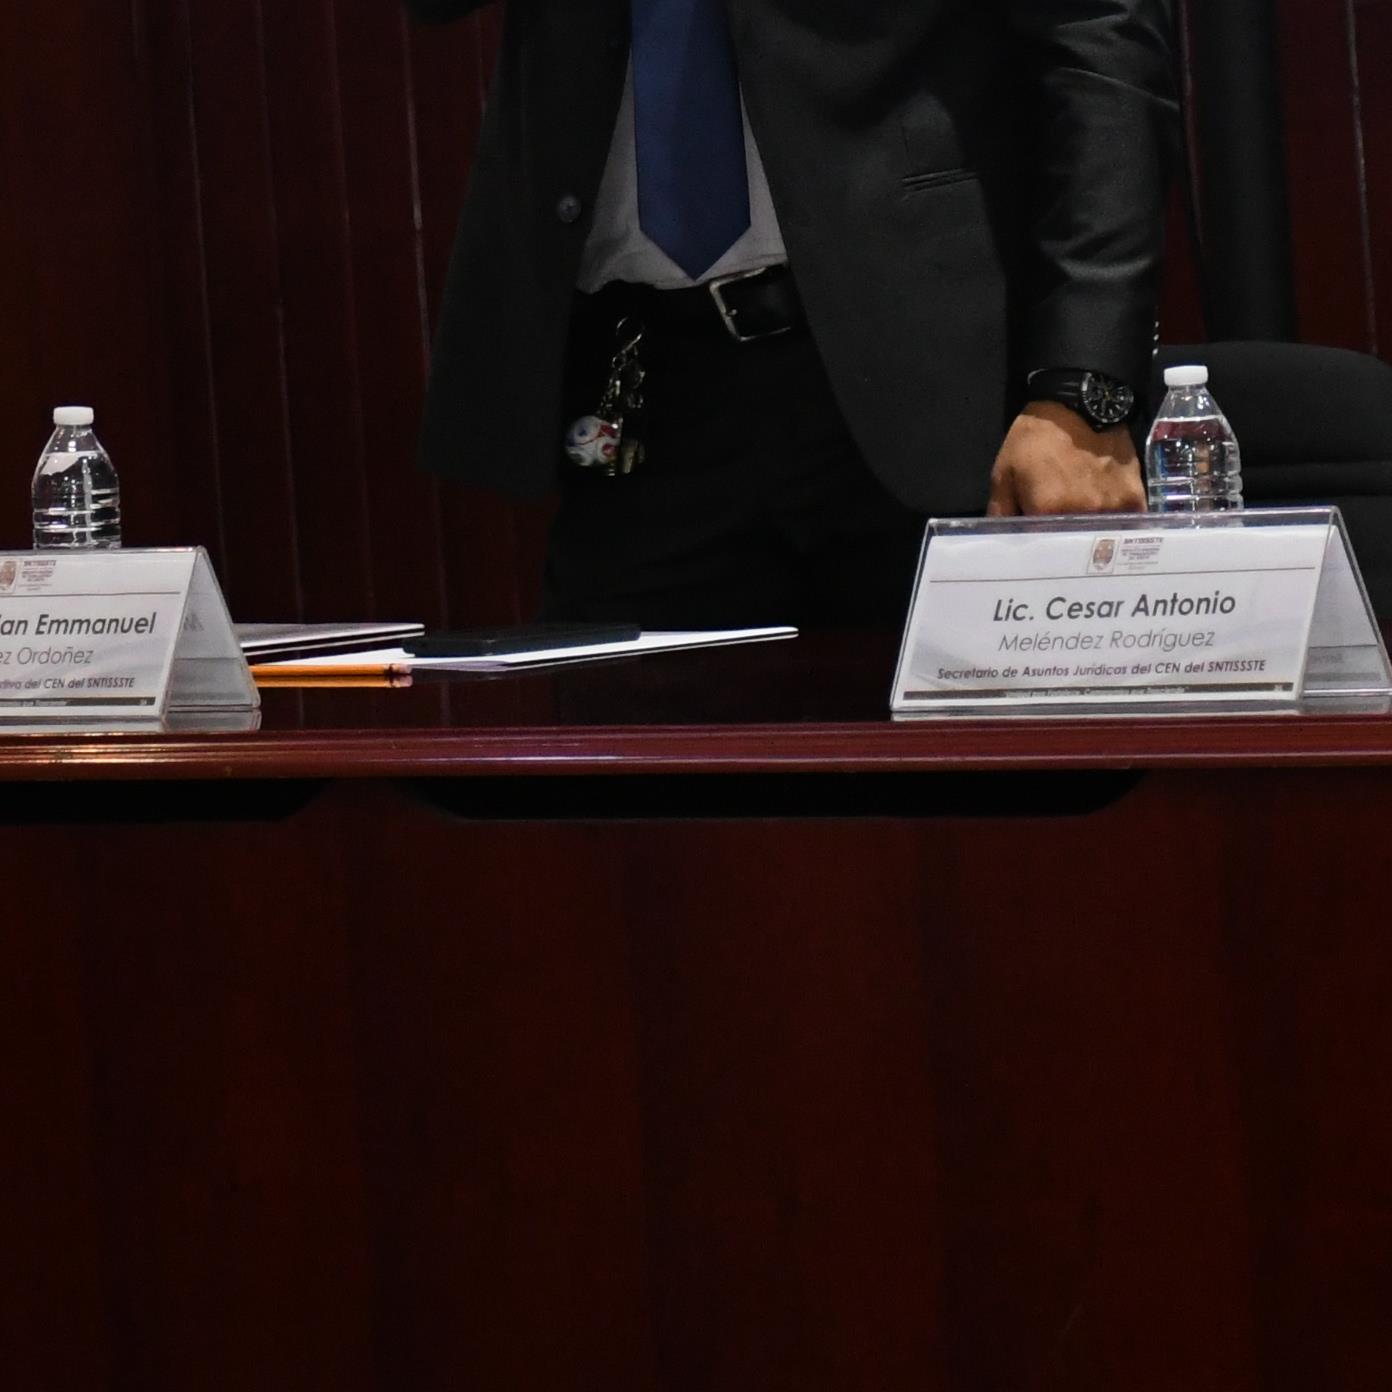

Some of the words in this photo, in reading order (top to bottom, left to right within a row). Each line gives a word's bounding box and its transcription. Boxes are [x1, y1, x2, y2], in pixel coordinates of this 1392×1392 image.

[993, 599, 1035, 622] Lic.
[1046, 597, 1124, 620] Cesar
[1132, 591, 1236, 617] Antonio
[36, 612, 157, 635] Emmanuel
[998, 630, 1103, 653] Meléndez
[1111, 628, 1215, 653] Rodríguez
[17, 646, 94, 666] Ordoñez
[937, 668, 998, 681] Secretario
[1006, 667, 1018, 678] de
[1021, 666, 1069, 677] Asuntos
[1131, 664, 1151, 675] del
[1155, 663, 1180, 675] CEN
[1184, 662, 1204, 673] del
[1208, 660, 1265, 673] SNTISSSTE
[24, 678, 42, 689] del
[44, 678, 65, 689] CEN
[68, 677, 85, 689] del
